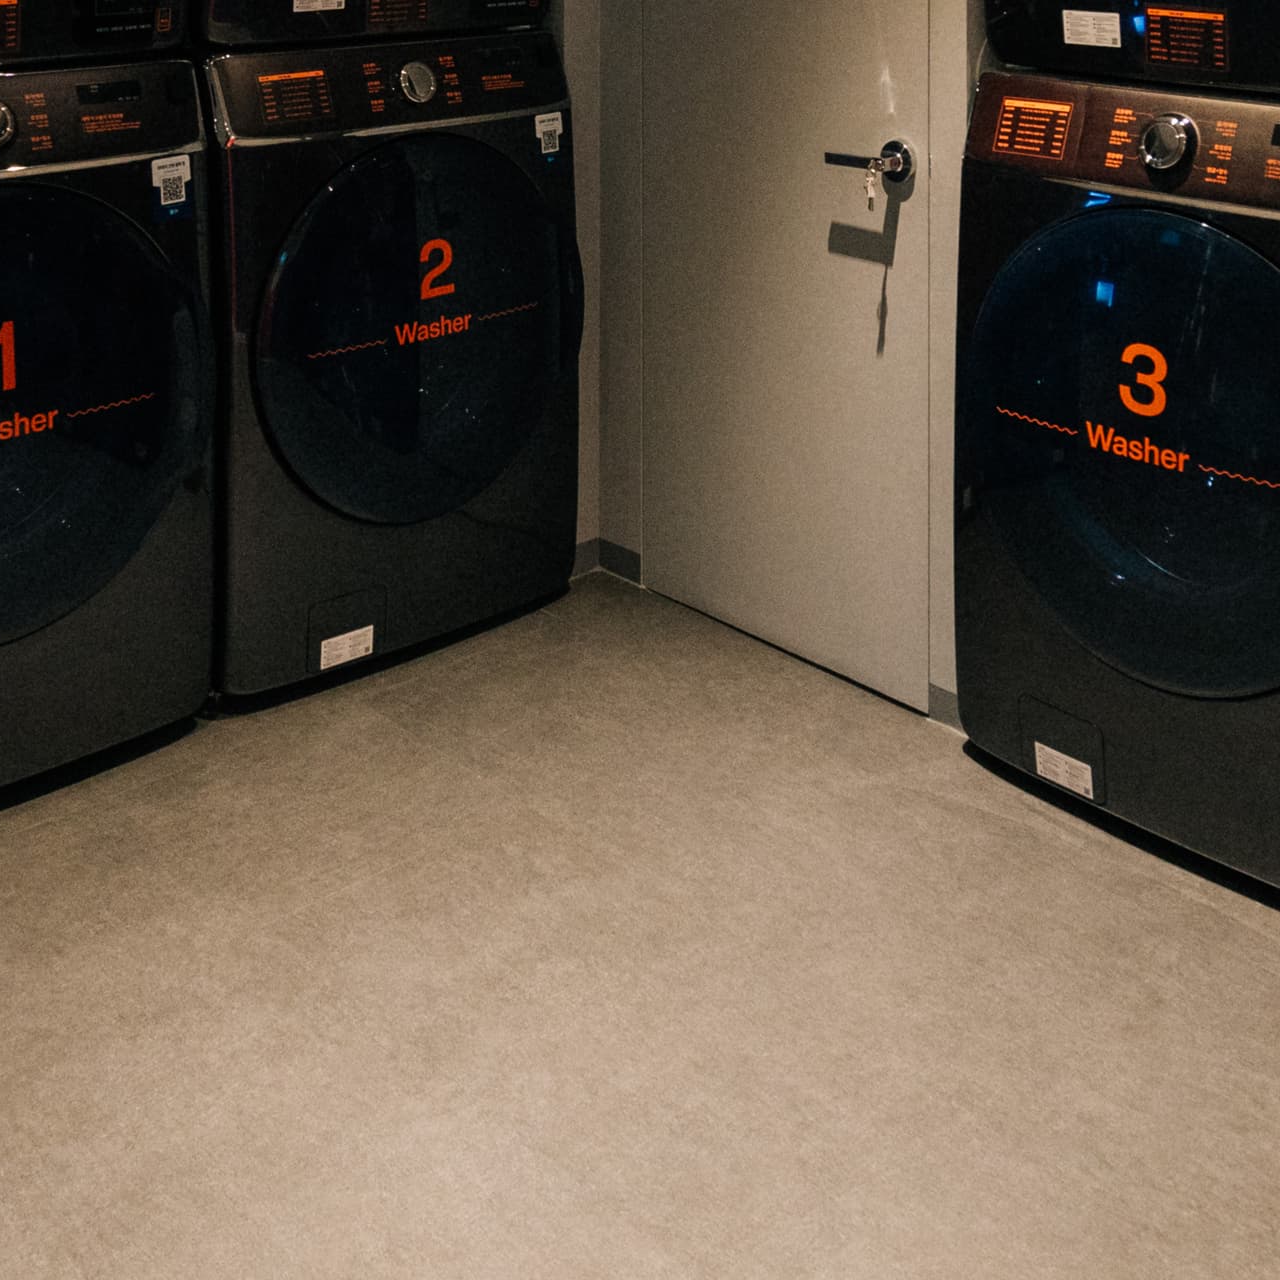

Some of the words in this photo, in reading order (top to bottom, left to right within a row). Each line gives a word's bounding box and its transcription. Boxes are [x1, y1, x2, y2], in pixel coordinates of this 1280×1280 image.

[418, 237, 457, 301] 2
[393, 313, 473, 347] Washer
[1117, 342, 1170, 418] 3
[1085, 419, 1191, 474] Washer
